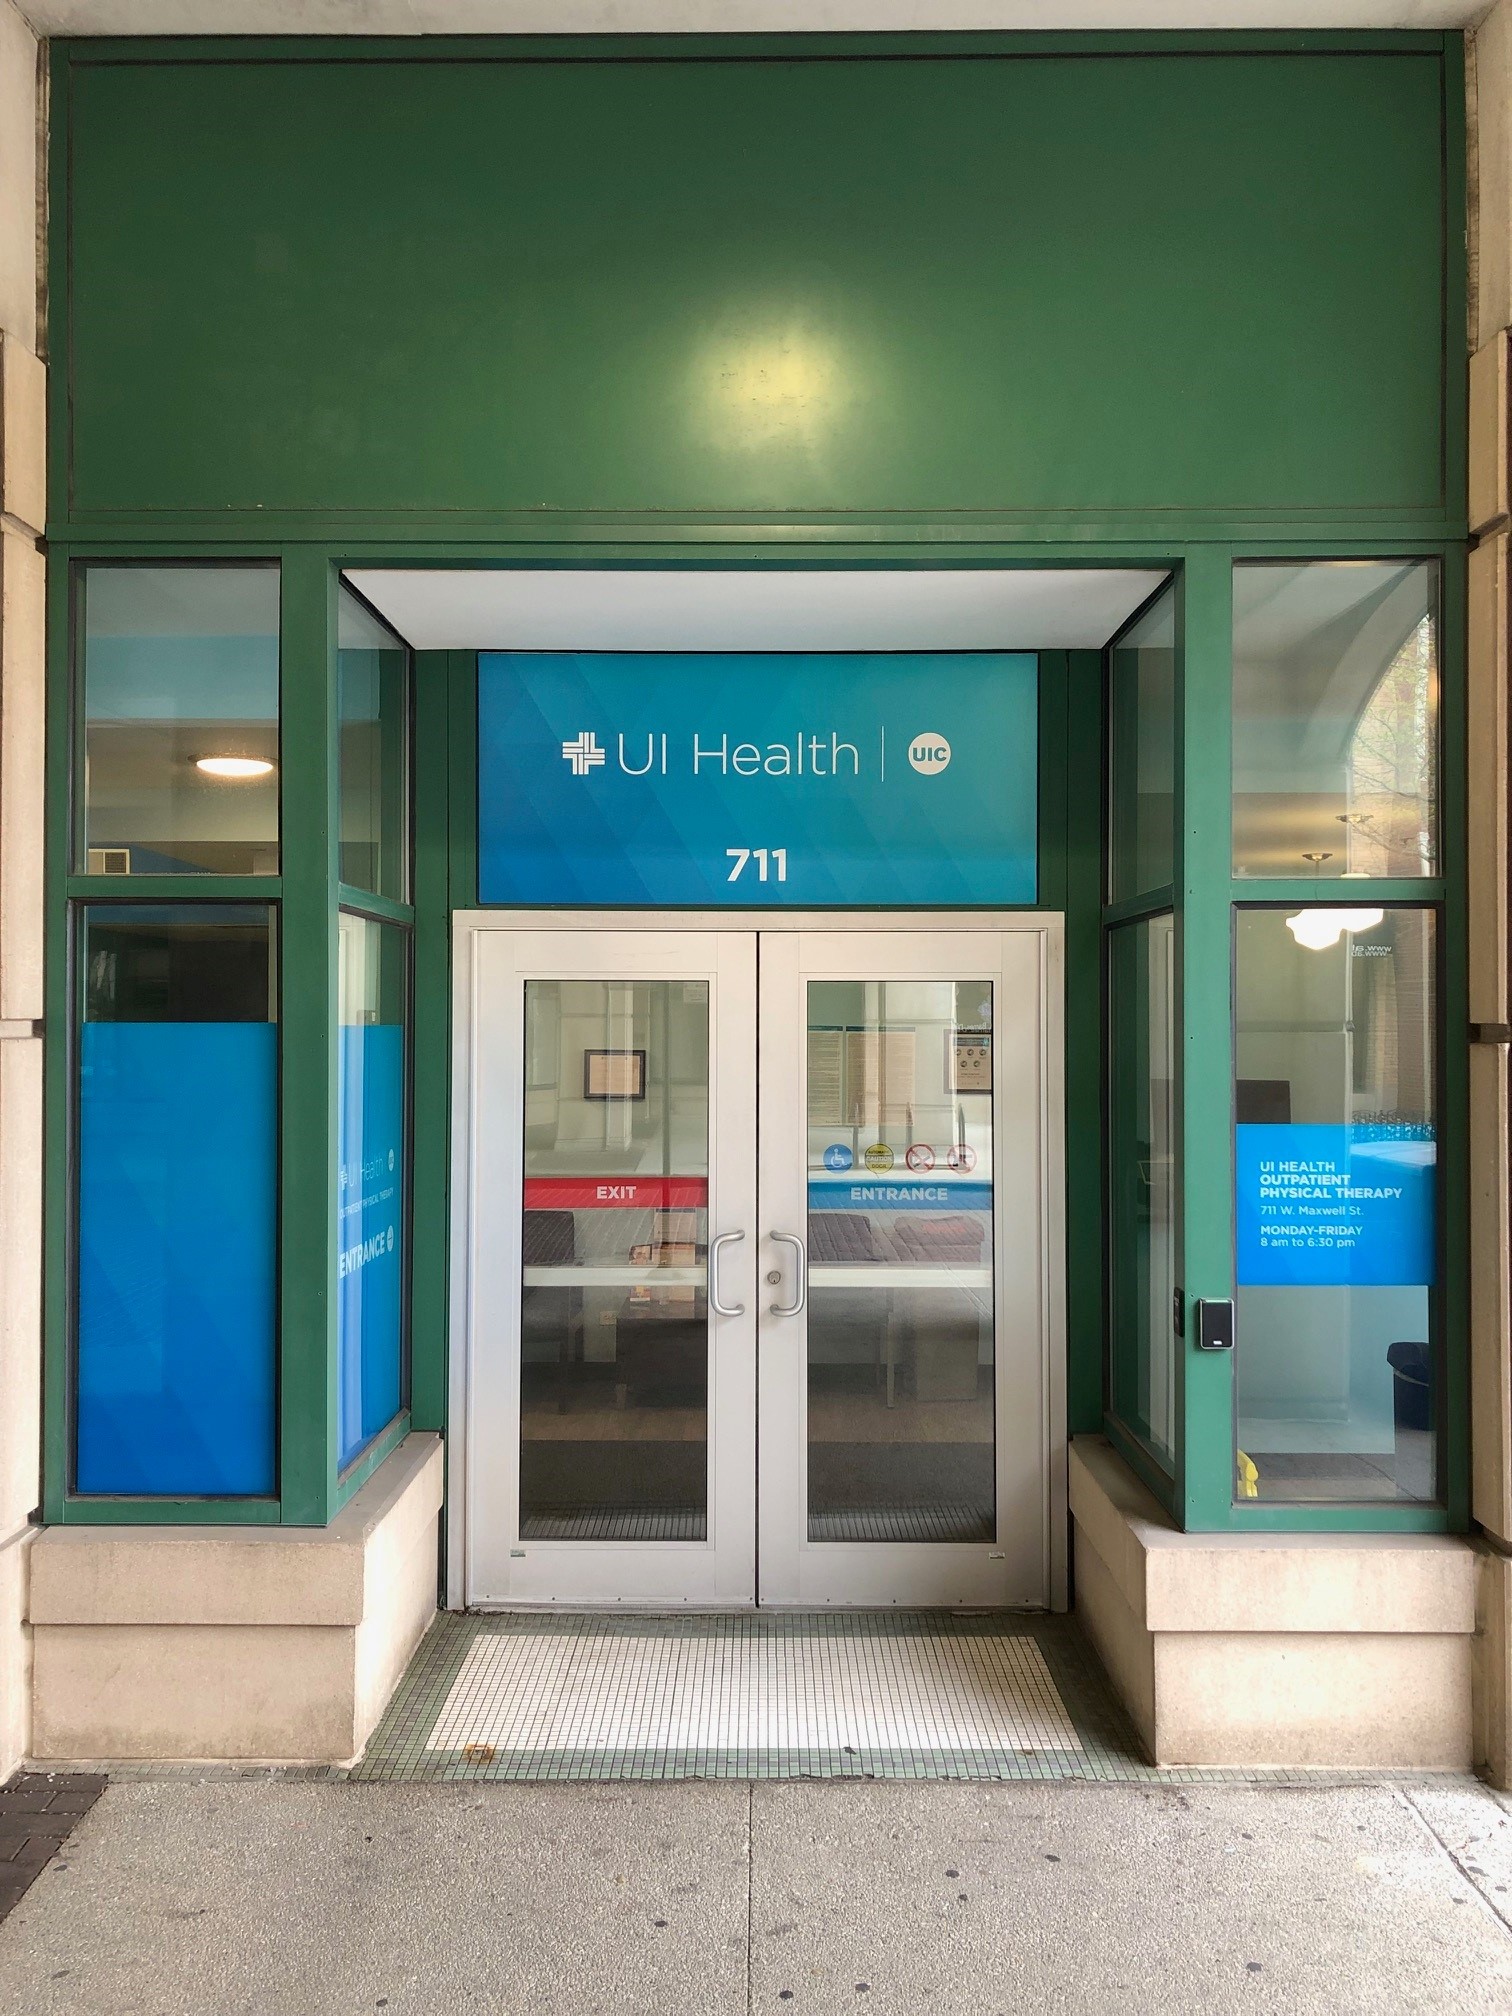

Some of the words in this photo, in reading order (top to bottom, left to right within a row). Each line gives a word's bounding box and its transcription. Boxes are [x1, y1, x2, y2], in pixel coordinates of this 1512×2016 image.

[618, 733, 667, 775] UI
[693, 732, 859, 776] Health
[912, 745, 947, 762] UIC
[726, 848, 787, 882] 711
[1260, 1161, 1275, 1173] UI
[1278, 1161, 1336, 1173] HEALTH
[1259, 1174, 1351, 1186] OUTPATIENT
[596, 1185, 637, 1200] EXIT
[850, 1186, 948, 1201] ENTRANCE
[1259, 1187, 1332, 1199] PHYSICAL
[1335, 1187, 1403, 1199] THERAPY
[1260, 1205, 1277, 1215] 711
[1280, 1205, 1295, 1215] W.
[1298, 1205, 1346, 1216] Maxwell
[1349, 1205, 1364, 1216] St.
[1260, 1225, 1363, 1236] MONDAY-FRIDAY
[1260, 1237, 1268, 1247] 8
[1271, 1239, 1289, 1247] am
[1292, 1238, 1304, 1247] to
[1307, 1237, 1334, 1247] 6:30
[1336, 1239, 1356, 1249] pm
[339, 1231, 386, 1279] ENTRANCE
